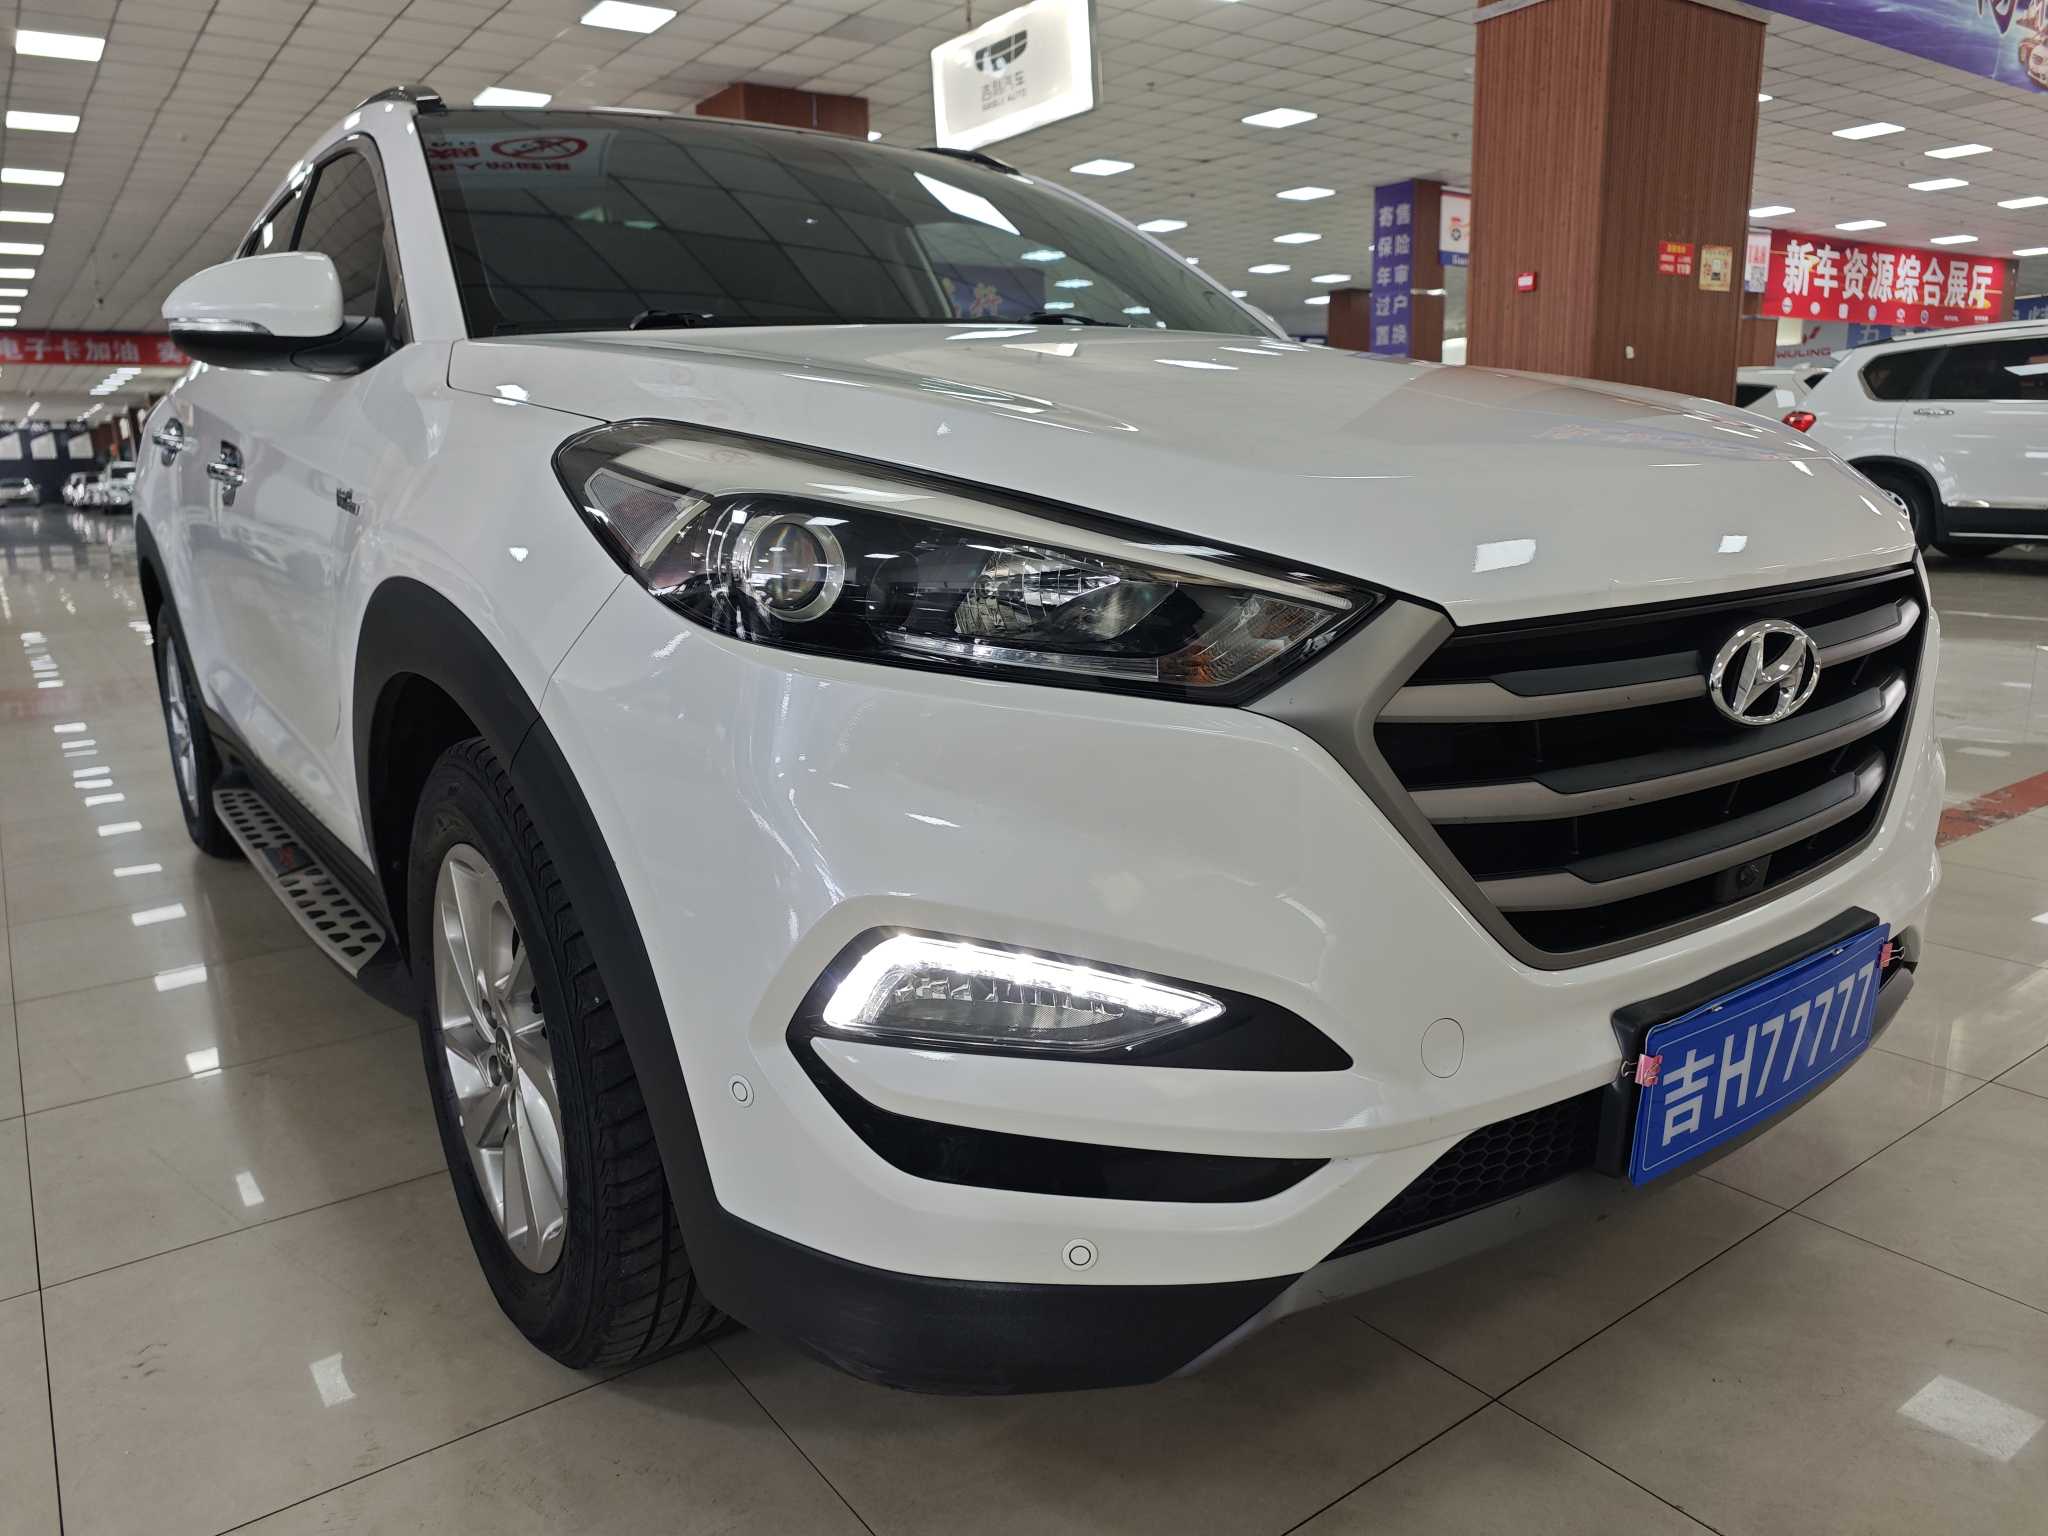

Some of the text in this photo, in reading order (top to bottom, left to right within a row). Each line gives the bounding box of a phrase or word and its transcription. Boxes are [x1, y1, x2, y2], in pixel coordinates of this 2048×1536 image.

[1783, 239, 1994, 310] 新车资源综合展厅
[1776, 346, 1832, 359] WULING
[1661, 959, 1876, 1147] 吉H77777
